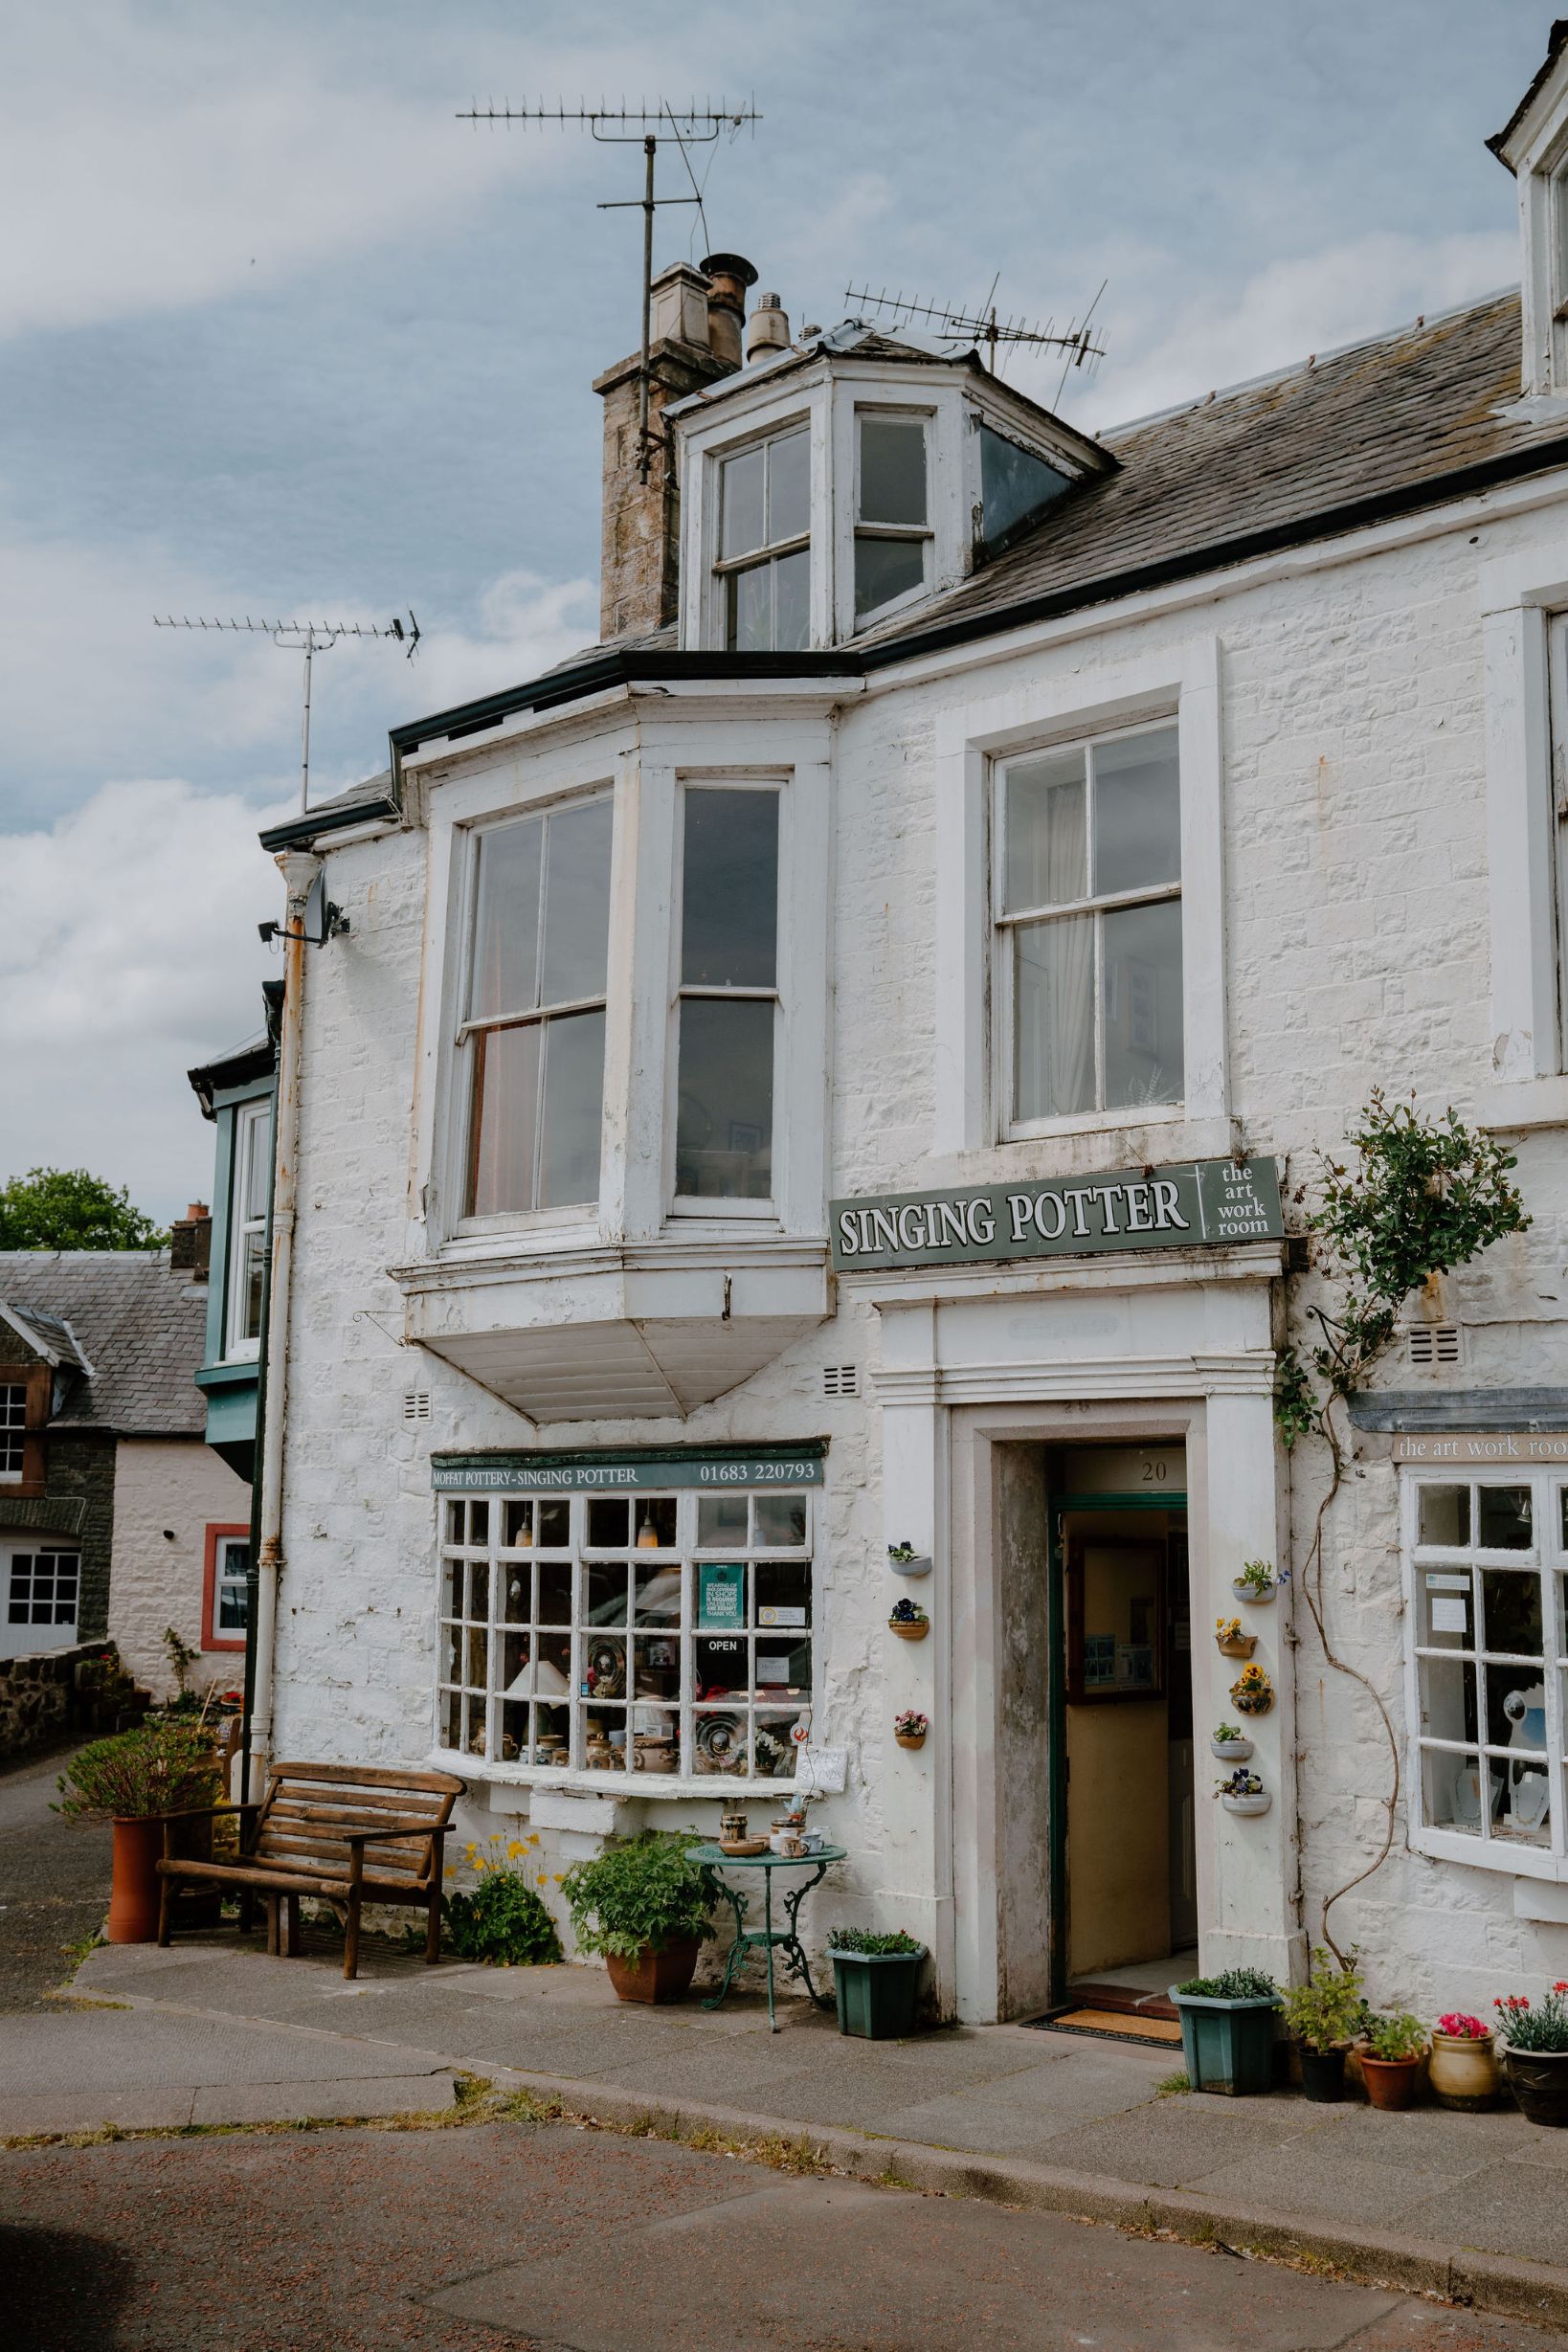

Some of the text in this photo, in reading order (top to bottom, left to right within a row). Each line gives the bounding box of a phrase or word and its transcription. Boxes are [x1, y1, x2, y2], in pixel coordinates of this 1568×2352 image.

[1222, 1162, 1253, 1182] the
[1225, 1183, 1253, 1199] art
[839, 1179, 1191, 1257] SINGING POTTER
[1218, 1197, 1266, 1219] work
[1219, 1220, 1269, 1236] room
[1399, 1435, 1568, 1456] the art work roo
[433, 1471, 462, 1486] MOFFAT
[576, 1468, 639, 1484] POTTER
[700, 1465, 749, 1482] 01683
[754, 1463, 815, 1480] 220793
[1142, 1462, 1167, 1481] 20
[708, 1641, 737, 1650] OPEN
